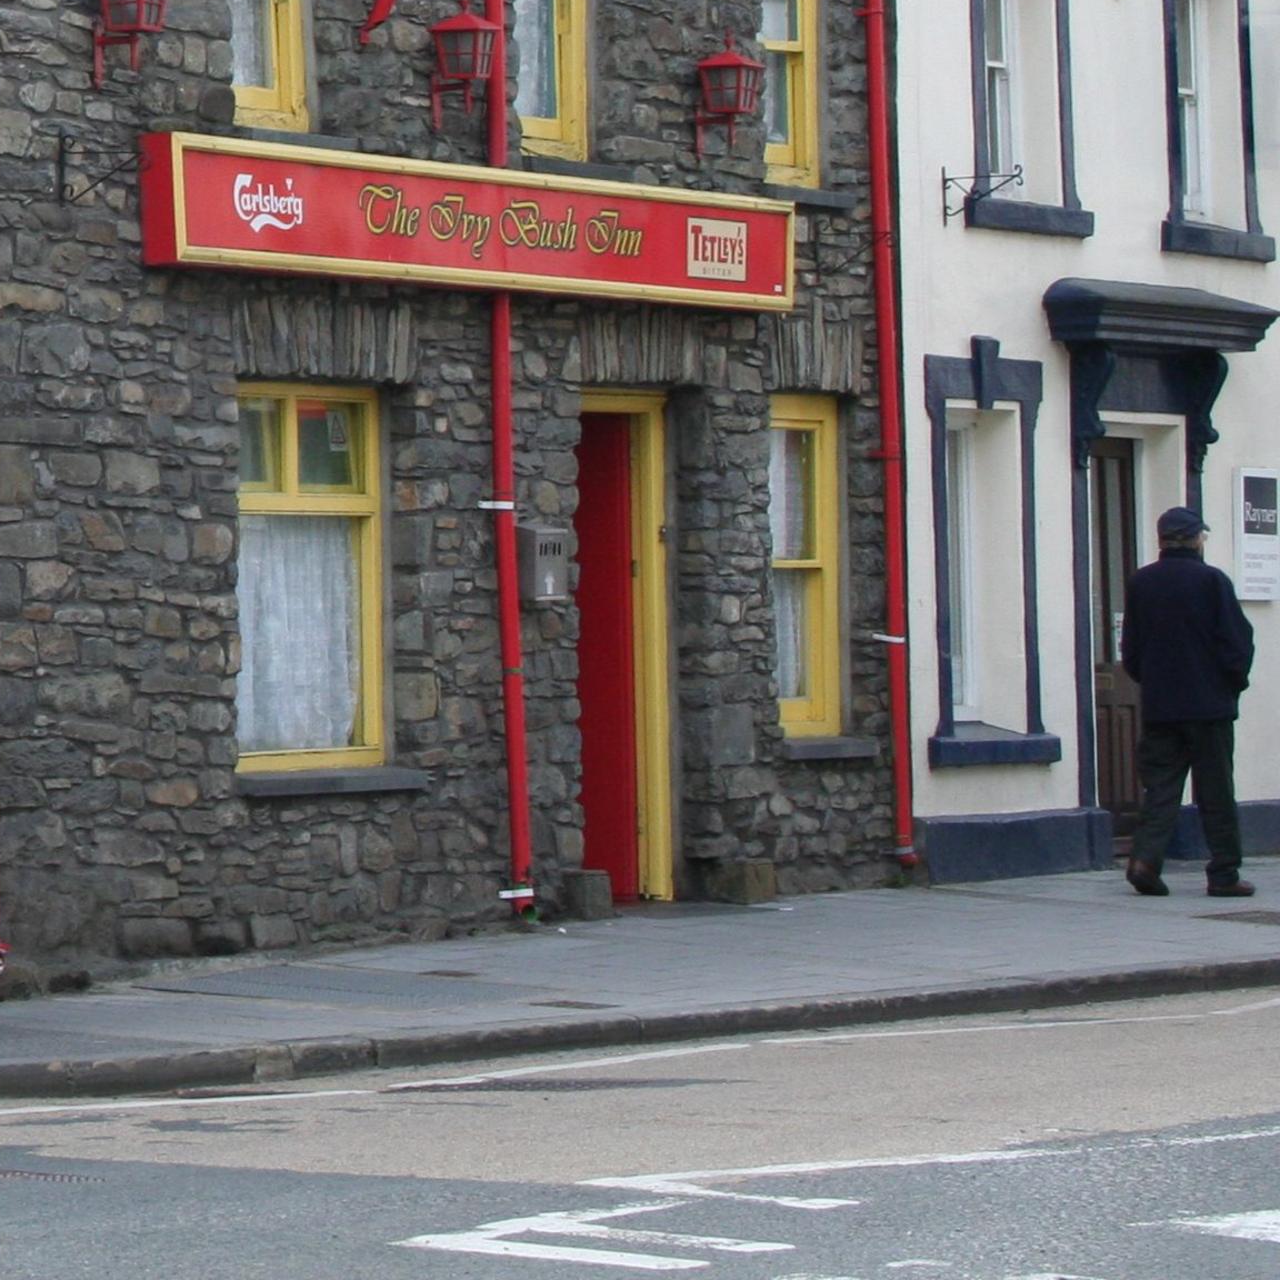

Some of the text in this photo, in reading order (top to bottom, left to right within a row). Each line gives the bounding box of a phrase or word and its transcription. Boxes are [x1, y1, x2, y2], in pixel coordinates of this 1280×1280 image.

[233, 173, 304, 233] Carlsberg
[359, 184, 644, 259] The Ivy Bush Inn
